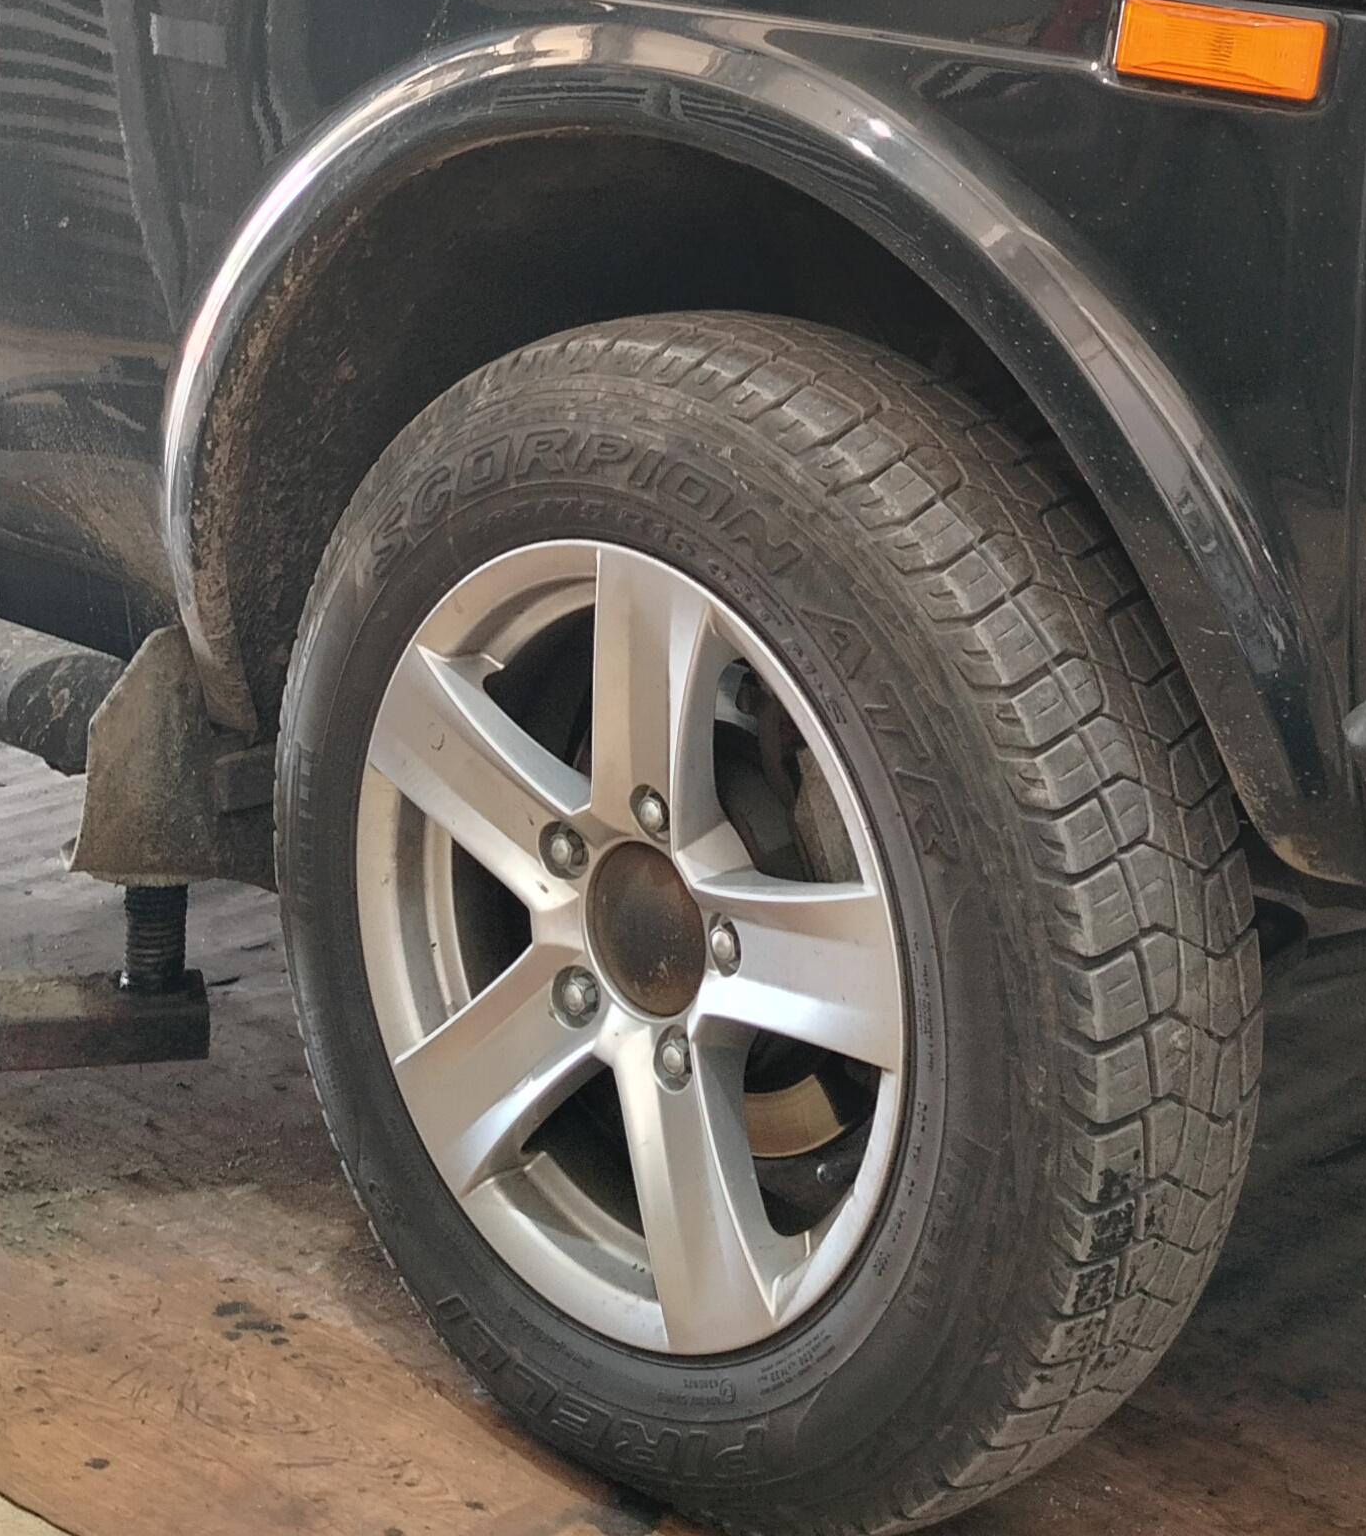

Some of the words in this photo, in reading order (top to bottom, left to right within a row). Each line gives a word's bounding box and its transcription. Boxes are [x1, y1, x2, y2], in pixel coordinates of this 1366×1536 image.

[370, 426, 805, 577] SCORPION
[799, 604, 962, 862] ATR
[435, 1292, 771, 1478] PIRELLI
